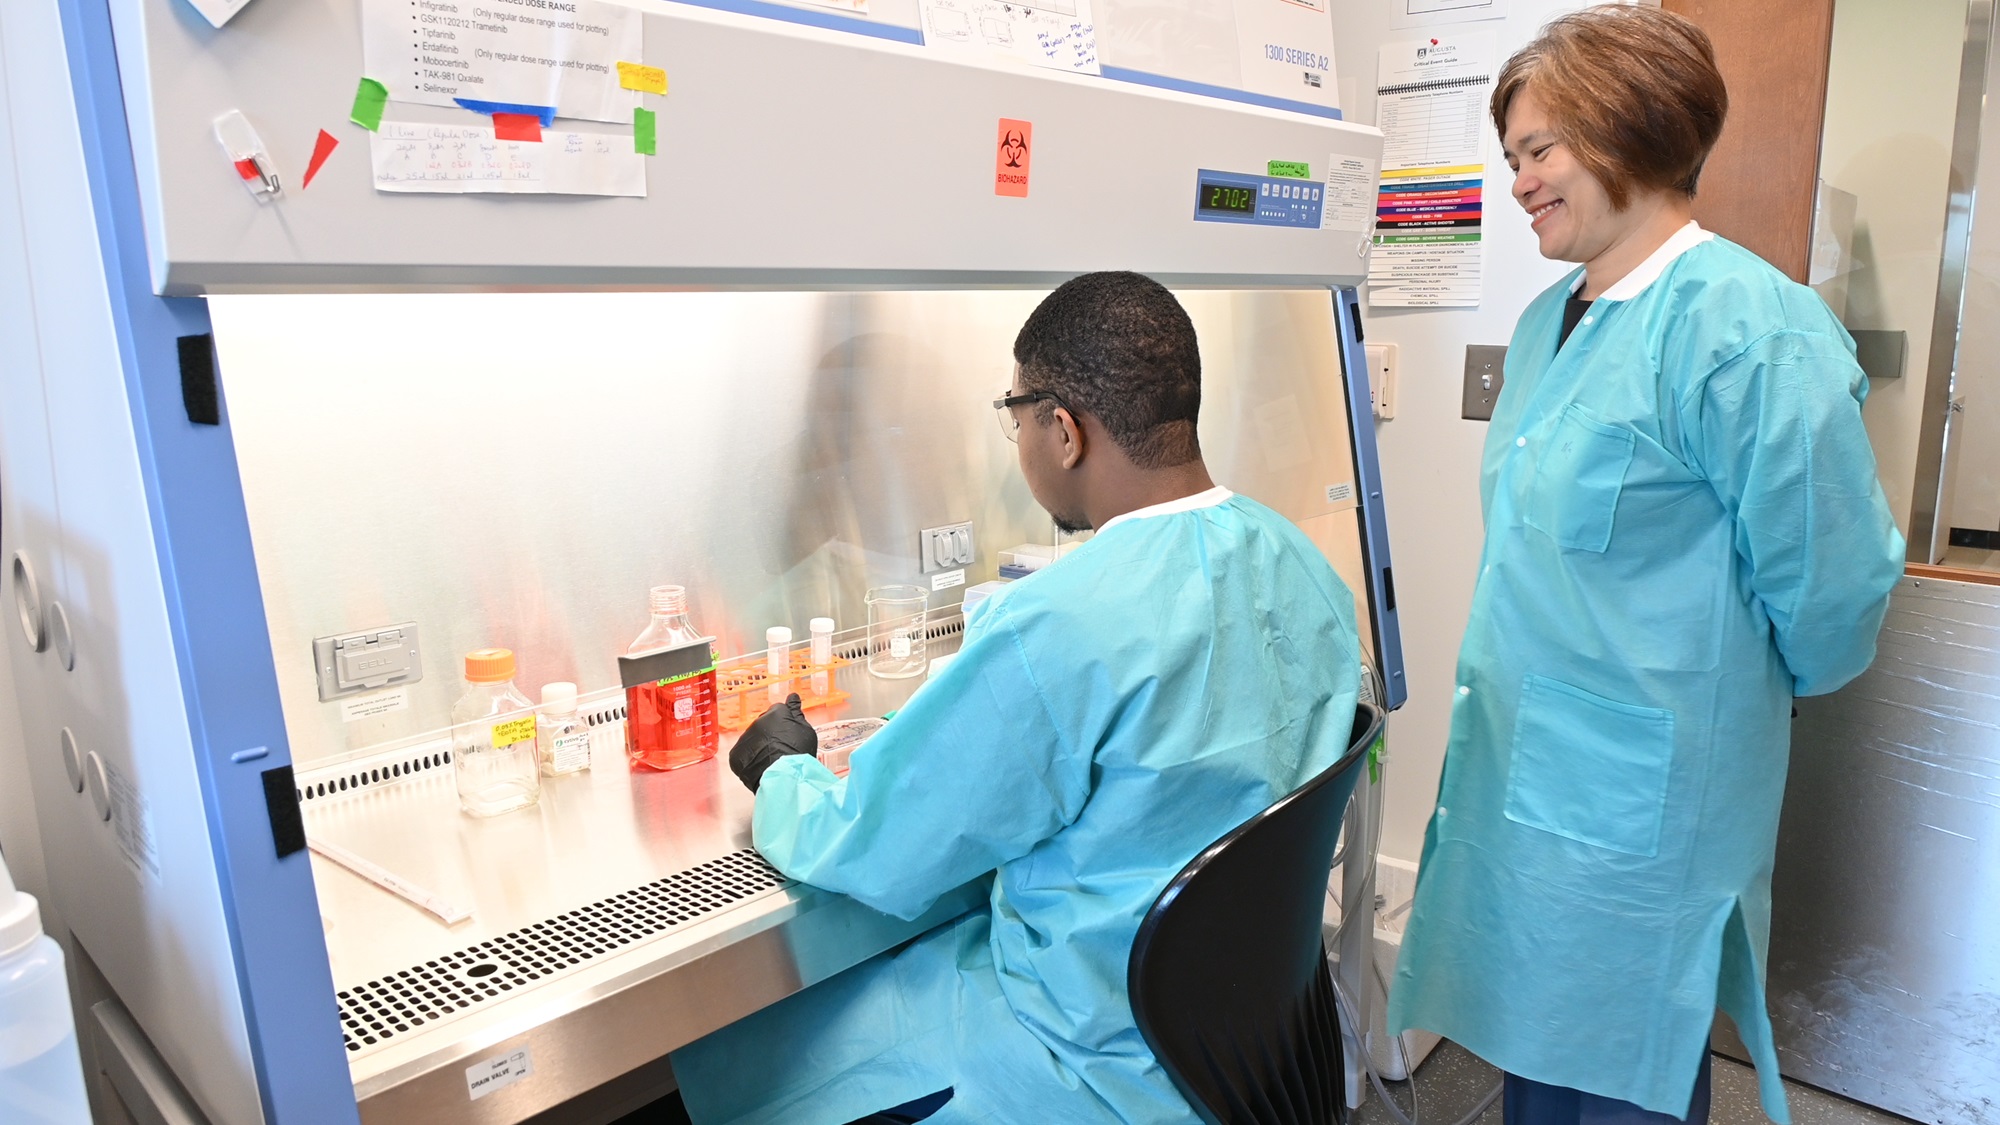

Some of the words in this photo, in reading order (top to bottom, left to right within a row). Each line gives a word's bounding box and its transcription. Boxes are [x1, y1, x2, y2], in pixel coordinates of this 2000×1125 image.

[420, 0, 458, 13] Infigratinib
[525, 0, 547, 9] DOSE
[548, 1, 576, 13] RANGE
[420, 13, 469, 28] GSK1120212
[471, 20, 508, 33] Trametinib
[473, 7, 491, 19] (Only
[494, 10, 517, 22] regular
[519, 14, 535, 24] dose
[536, 17, 556, 28] range
[557, 20, 574, 29] used
[576, 22, 585, 31] for
[585, 24, 609, 36] plotting)
[422, 41, 459, 54] Erdafitinib
[1429, 45, 1456, 54] AUGUSTA
[423, 56, 469, 69] Mobocertinib
[474, 48, 493, 60] (Only
[494, 51, 518, 63] regular
[520, 54, 536, 64] dose
[538, 57, 557, 68] range
[559, 59, 574, 69] used
[576, 60, 585, 70] for
[585, 62, 610, 74] plotting)
[1264, 43, 1284, 61] 1300
[1285, 47, 1316, 69] SERIES
[1317, 55, 1329, 71] A2
[423, 69, 456, 81] TAK-981
[457, 73, 484, 84] Oxalate
[423, 83, 457, 94] Selinexor
[997, 173, 1028, 185] BIOHAZARD
[1211, 187, 1249, 208] 2702
[564, 736, 579, 744] cytiva
[470, 1076, 490, 1090] DRAIN
[490, 1067, 510, 1080] VALVE
[515, 1068, 526, 1077] OPEN
